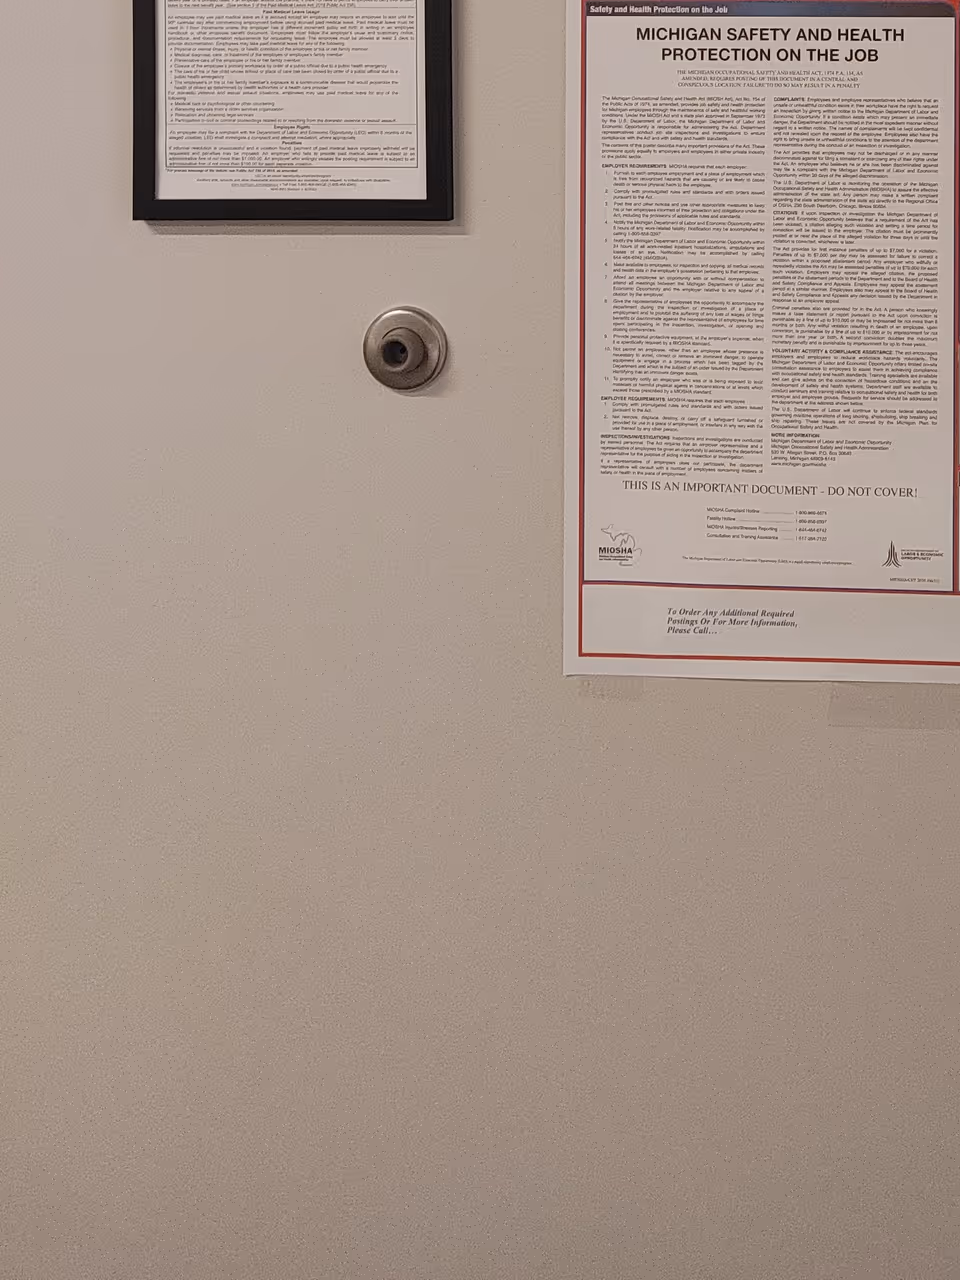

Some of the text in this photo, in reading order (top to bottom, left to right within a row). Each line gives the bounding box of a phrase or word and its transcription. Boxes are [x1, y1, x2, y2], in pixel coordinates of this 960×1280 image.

[590, 6, 613, 14] Safety
[636, 28, 904, 42] MICHIGAN SAFETY AND HEALTH
[662, 48, 878, 62] PROTECTION ON THE JOB
[623, 480, 648, 490] THIS
[651, 481, 661, 490] IS
[663, 482, 680, 491] AN
[683, 482, 749, 493] IMPORTANT
[751, 485, 818, 495] DOCUMENT
[828, 486, 845, 496] DO
[847, 487, 872, 496] NOT
[874, 487, 918, 497] COVER!
[761, 610, 795, 619] Required
[667, 619, 698, 627] Postings
